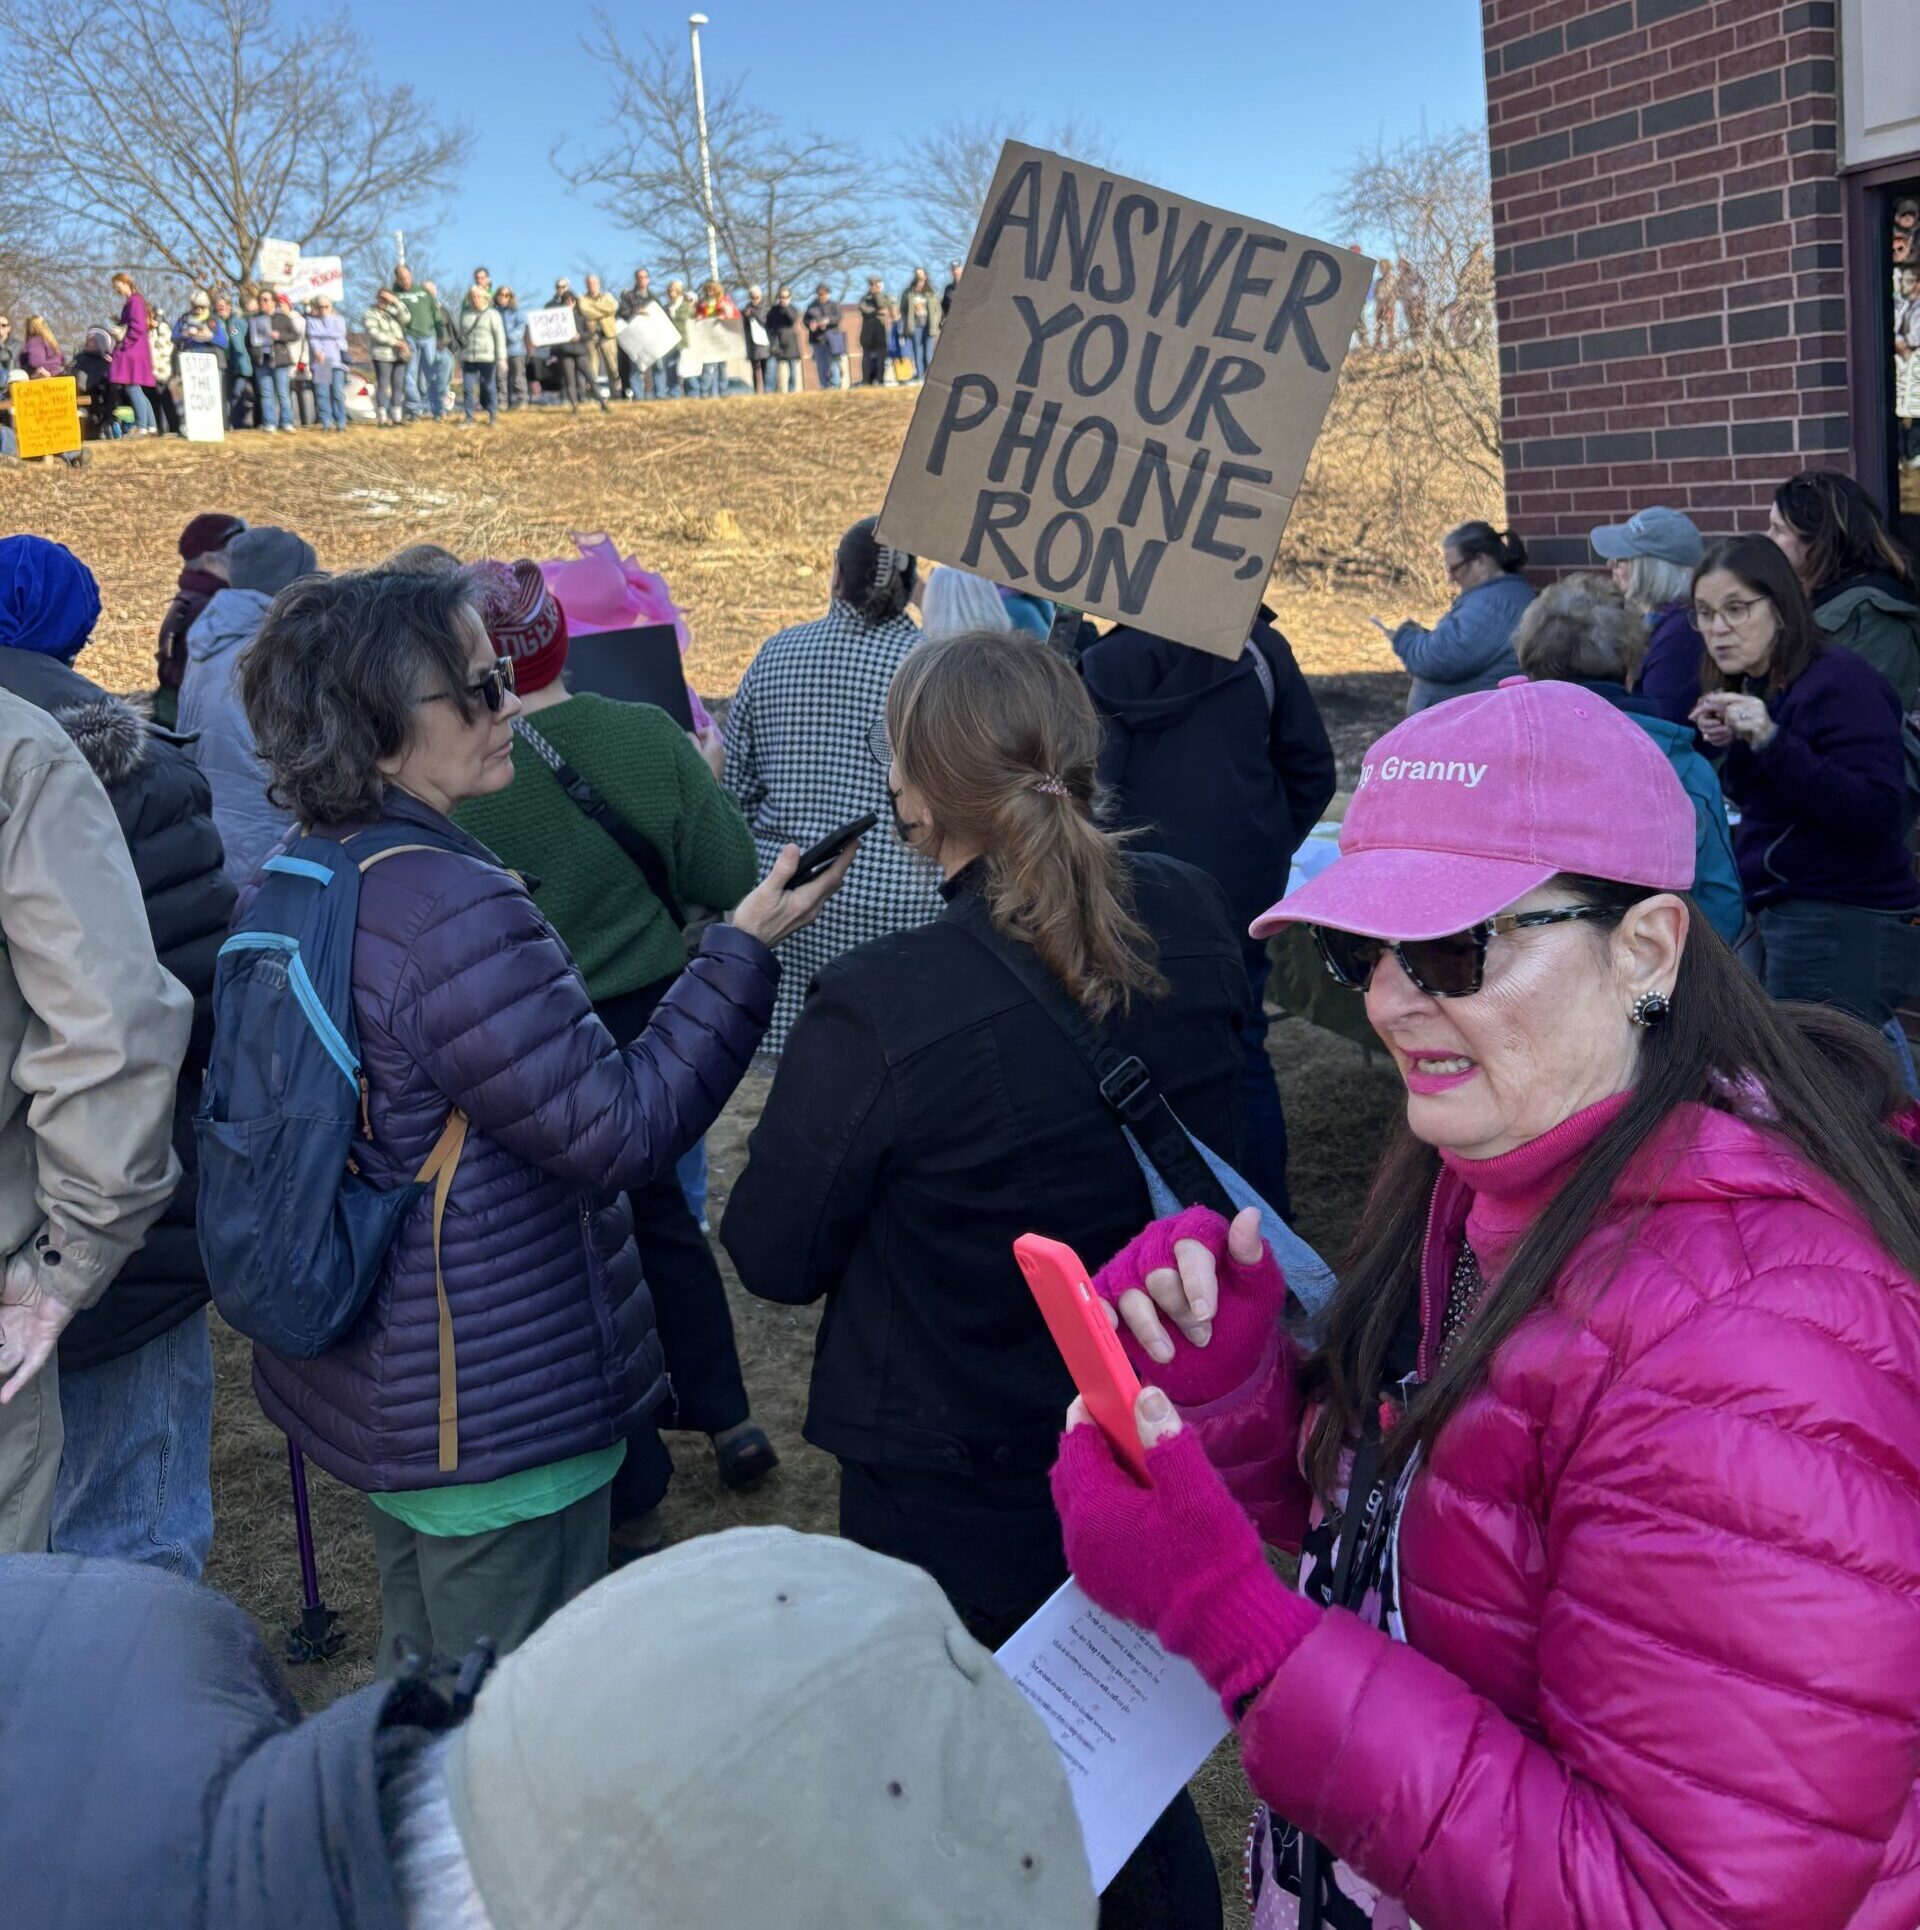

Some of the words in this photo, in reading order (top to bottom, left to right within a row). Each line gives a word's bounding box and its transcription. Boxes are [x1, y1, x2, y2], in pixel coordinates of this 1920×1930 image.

[973, 161, 1342, 373] ANSWER
[1012, 295, 1266, 456] YOUR
[925, 373, 1273, 580] PHONE,
[960, 489, 1168, 615] RON
[1381, 756, 1488, 788] Granny
